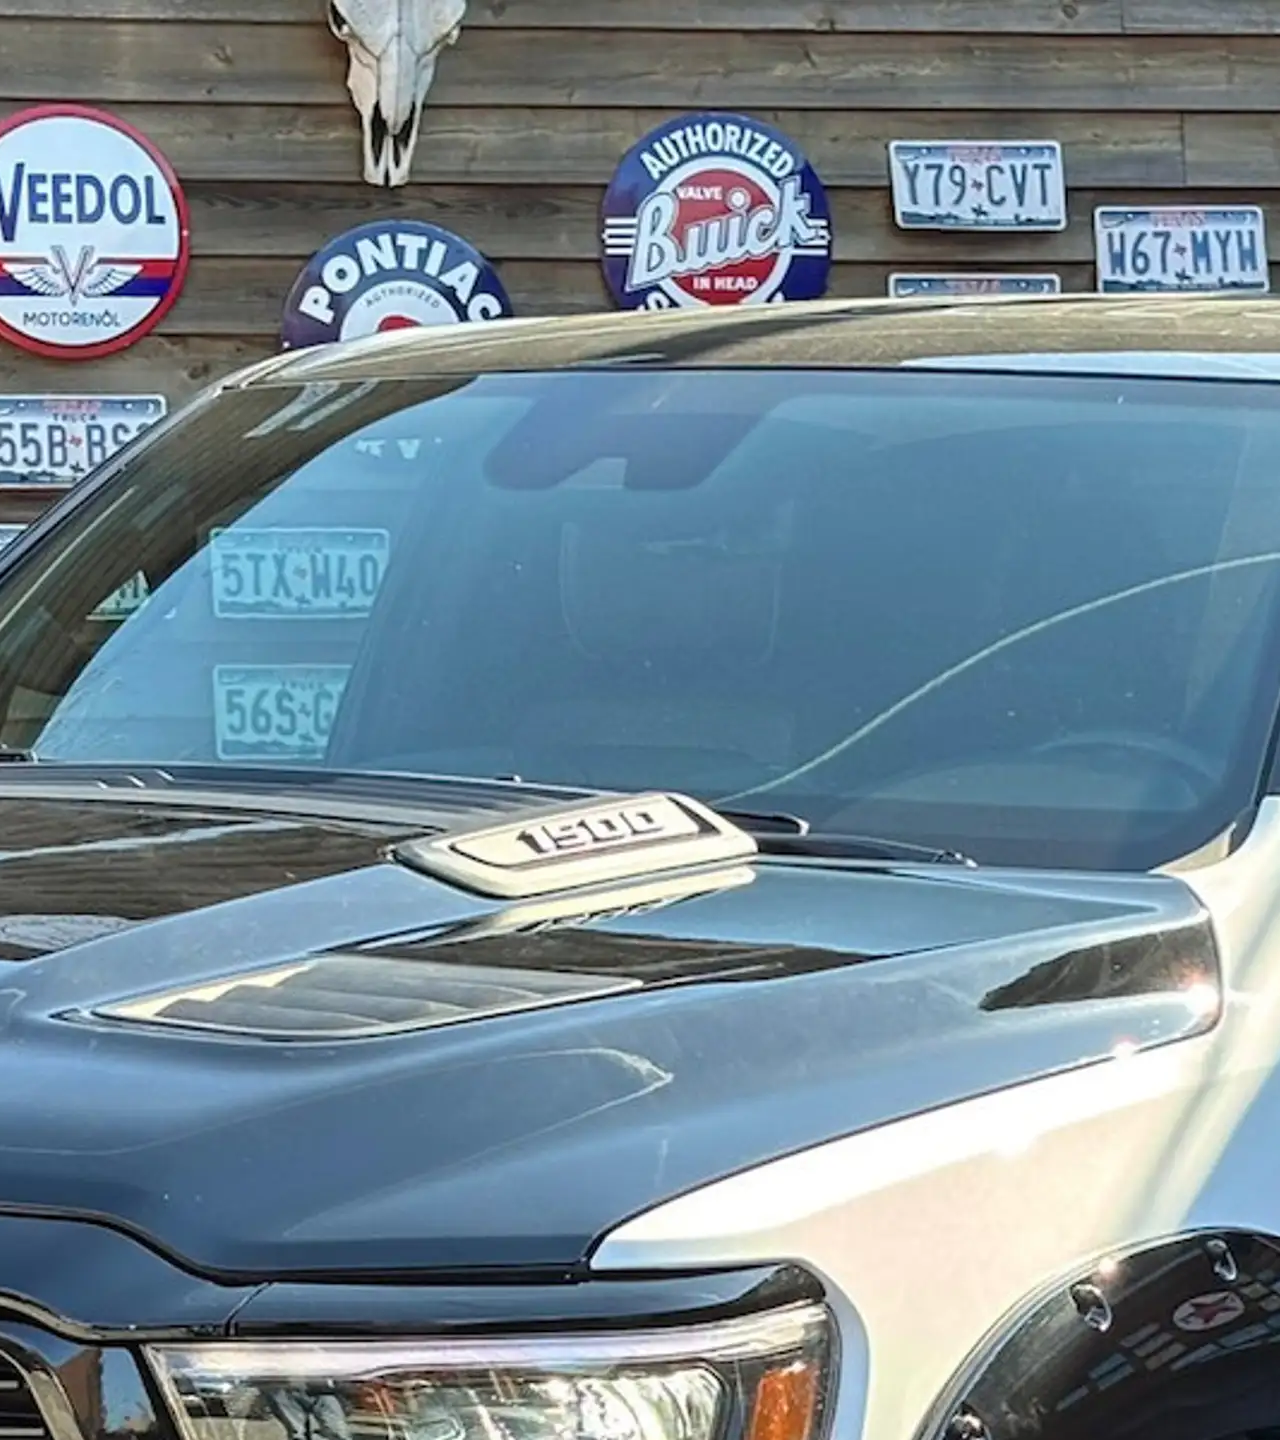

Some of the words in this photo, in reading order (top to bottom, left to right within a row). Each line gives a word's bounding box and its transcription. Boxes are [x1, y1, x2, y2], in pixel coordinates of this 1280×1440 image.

[640, 122, 795, 180] AUTHORIZED
[676, 185, 724, 201] VALVE
[903, 163, 967, 207] Y79
[986, 163, 1053, 207] CVT
[625, 174, 817, 292] Buick
[298, 232, 503, 326] PONTIAC
[365, 284, 441, 310] AUTHORIZED
[692, 276, 710, 291] IN
[714, 276, 760, 291] HEAD
[516, 810, 665, 856] 1500
